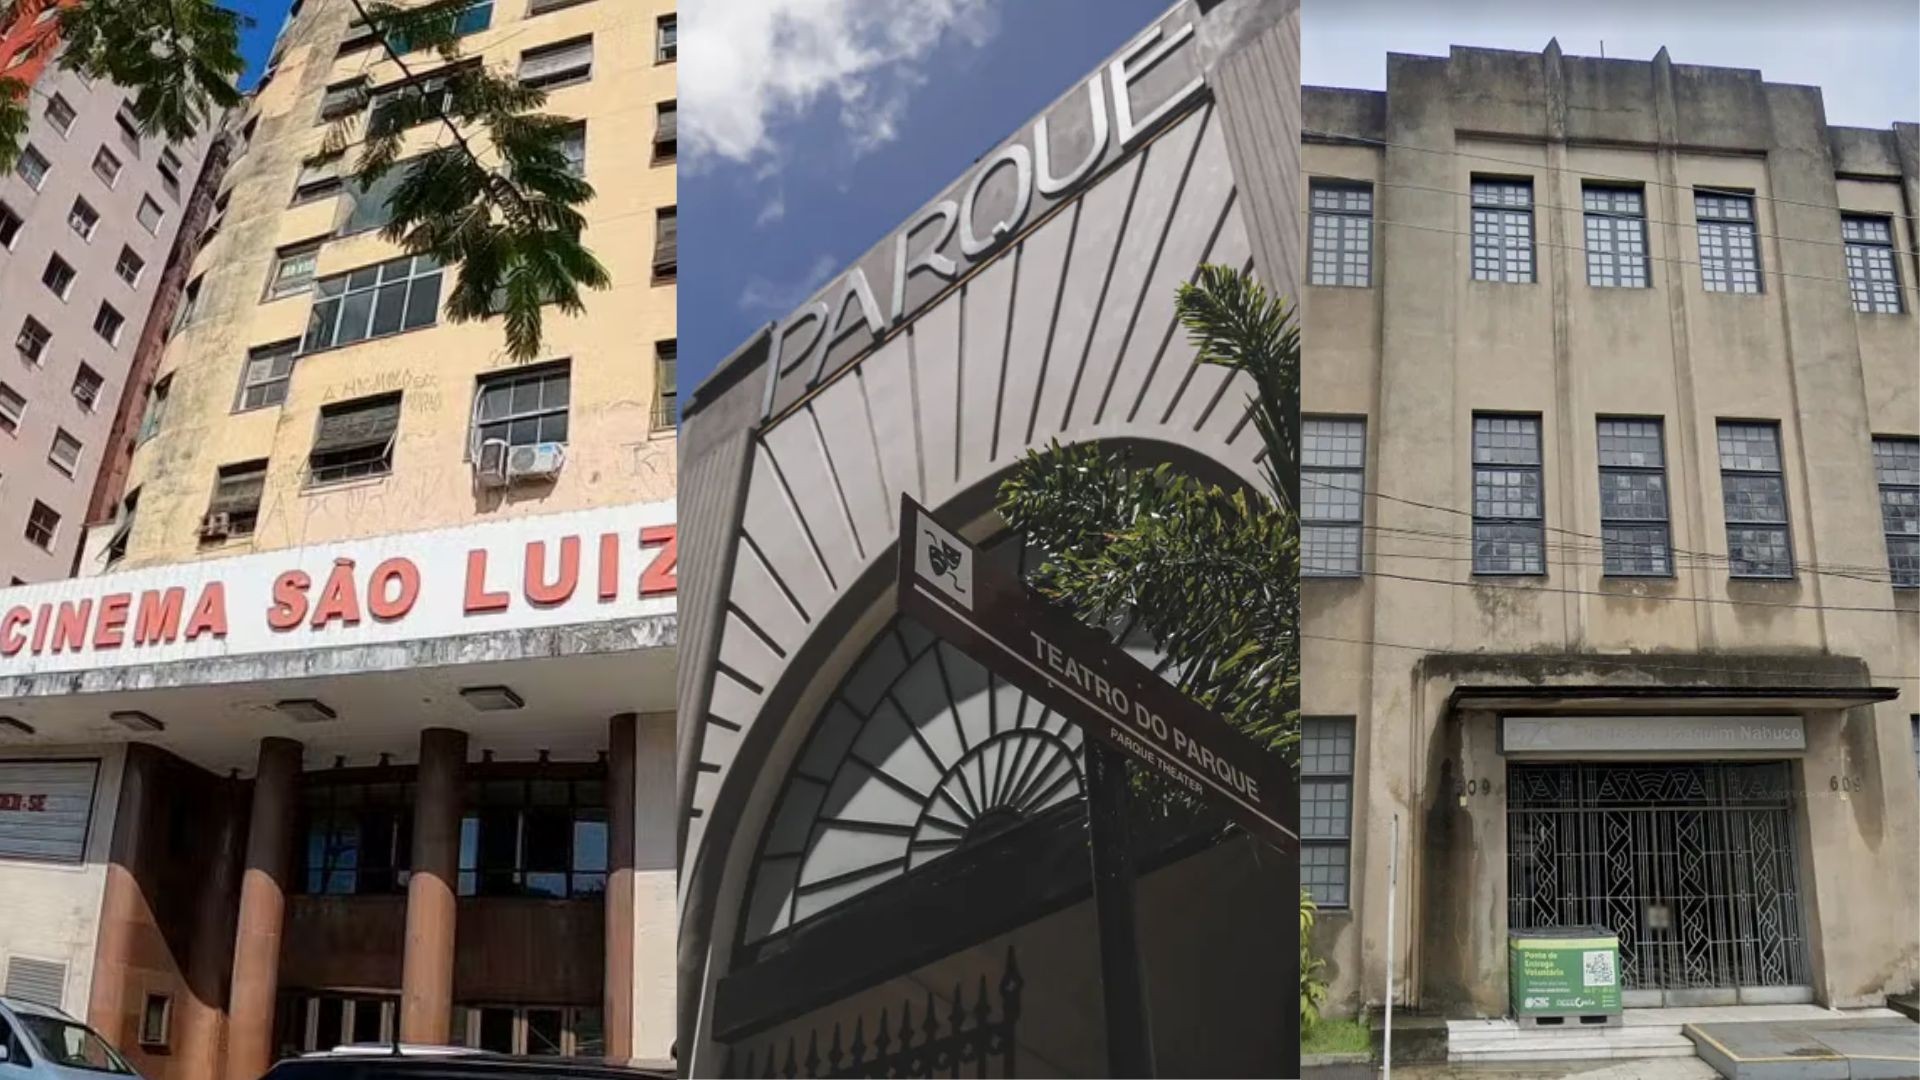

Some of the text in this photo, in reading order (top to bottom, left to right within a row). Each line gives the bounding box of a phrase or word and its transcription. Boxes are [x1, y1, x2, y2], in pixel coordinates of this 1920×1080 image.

[761, 22, 1206, 424] PARQUE
[0, 525, 677, 656] CINEMA SÃO LUIZ
[1030, 631, 1261, 803] TEATRO DO PARQUE
[1110, 728, 1204, 796] PARQUE THEATER
[1740, 725, 1801, 741] Nabuco
